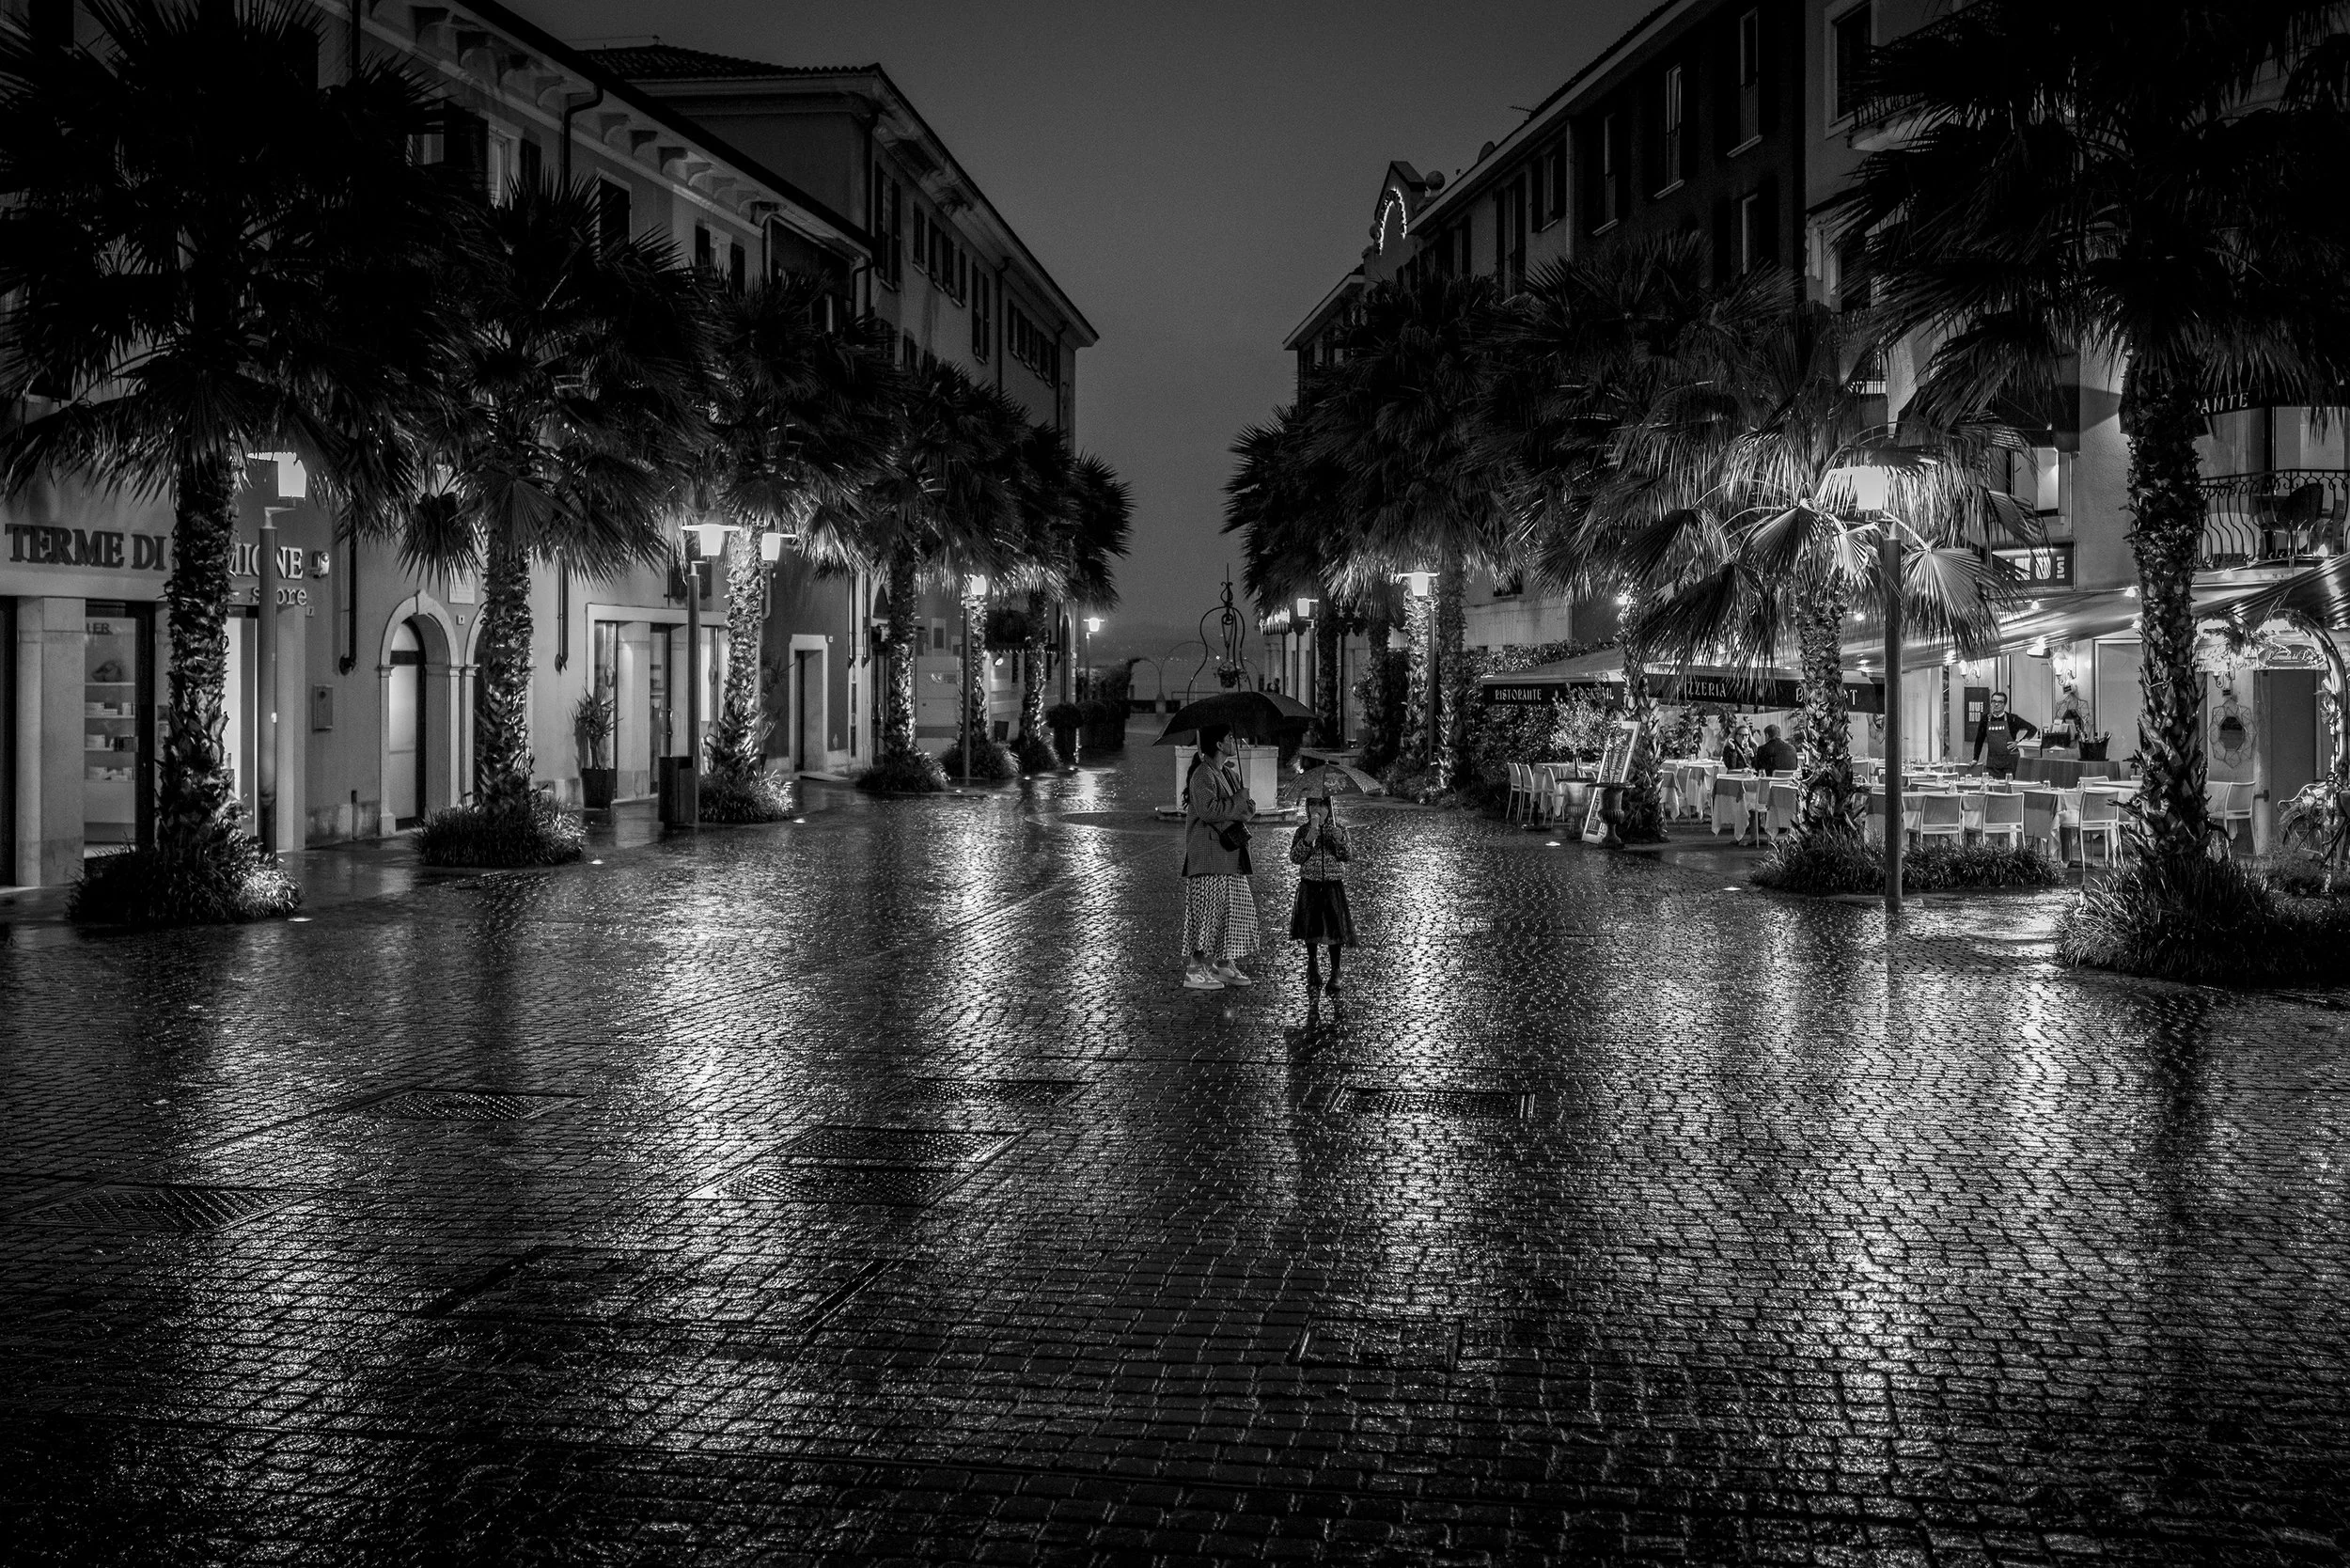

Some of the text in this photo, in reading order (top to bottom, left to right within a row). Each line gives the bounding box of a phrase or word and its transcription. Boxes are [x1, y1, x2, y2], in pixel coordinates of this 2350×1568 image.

[5, 523, 125, 569] TERME
[131, 533, 167, 572] DI
[250, 586, 307, 606] sore
[1495, 688, 1543, 701] RISTORANTE
[1677, 682, 1728, 698] ZZERIA
